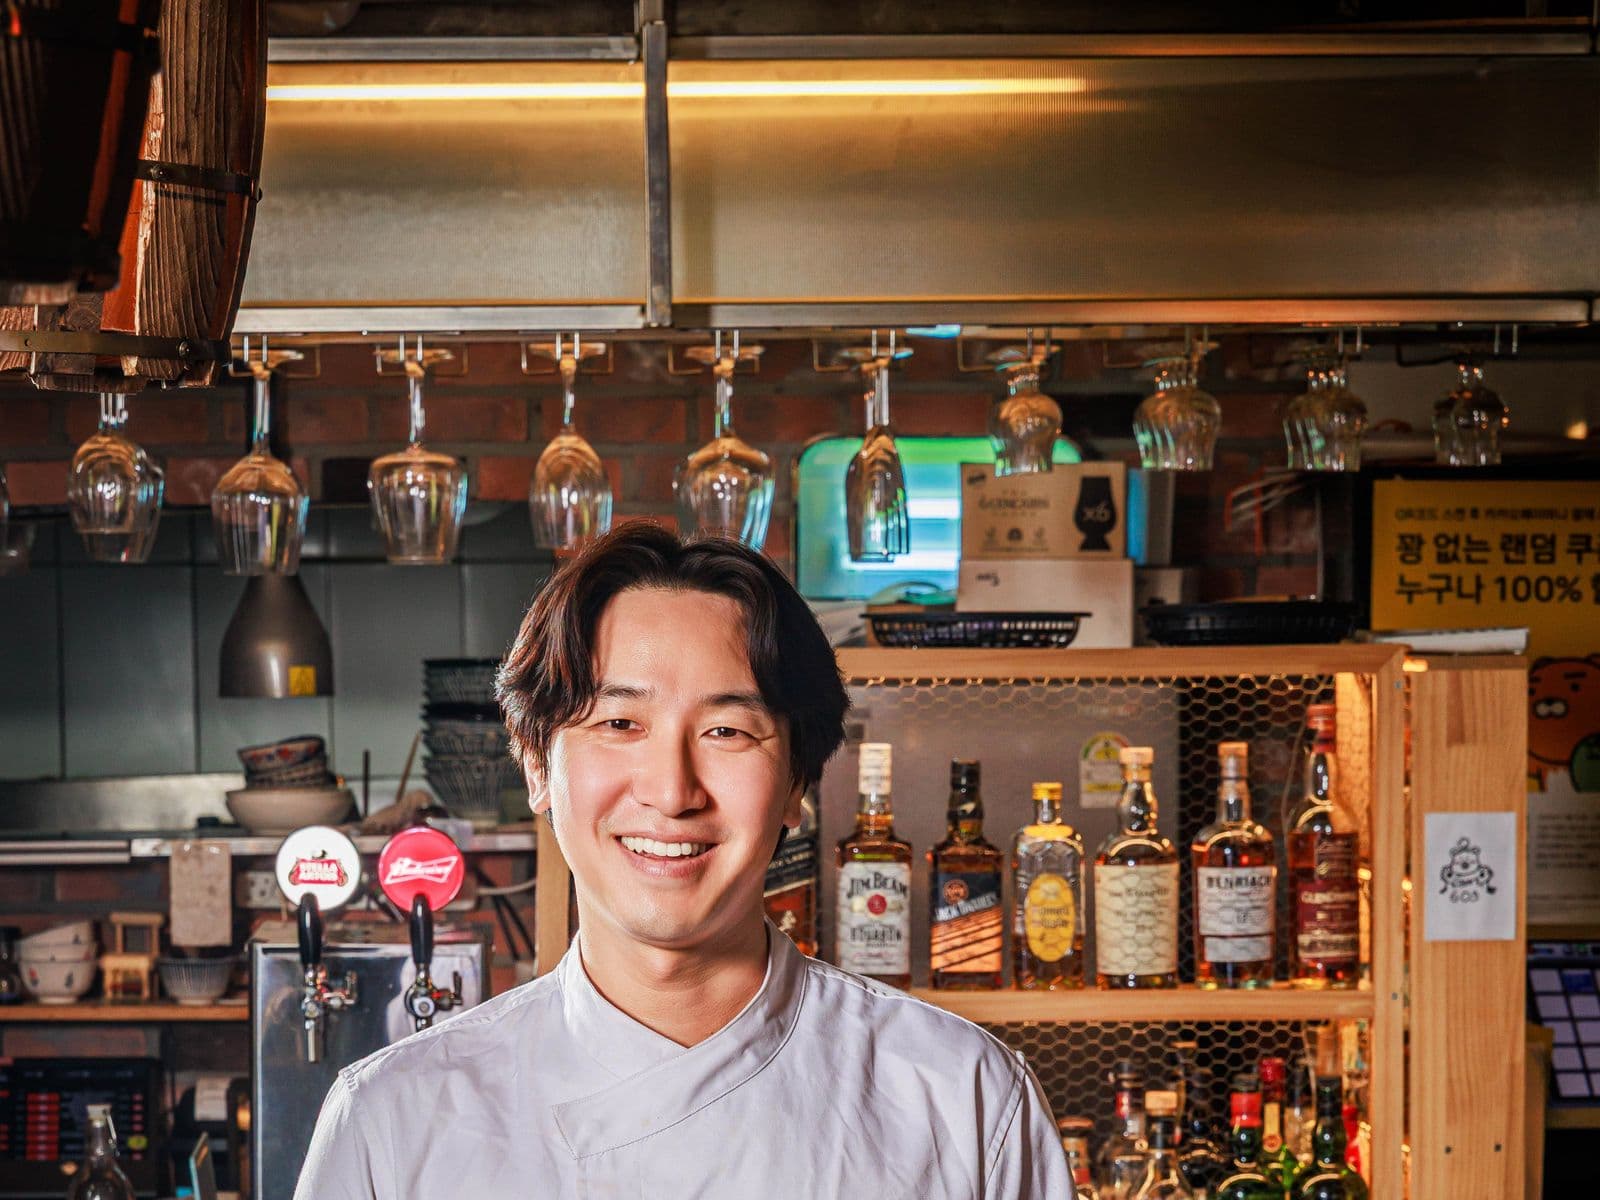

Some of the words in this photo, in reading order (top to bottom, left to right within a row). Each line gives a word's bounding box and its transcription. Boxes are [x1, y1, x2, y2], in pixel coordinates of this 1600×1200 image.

[1433, 532, 1491, 565] 없는
[1500, 532, 1557, 565] 랜덤
[1566, 533, 1600, 565] 쿠
[1396, 573, 1486, 605] 누구나
[1494, 575, 1583, 603] 100%
